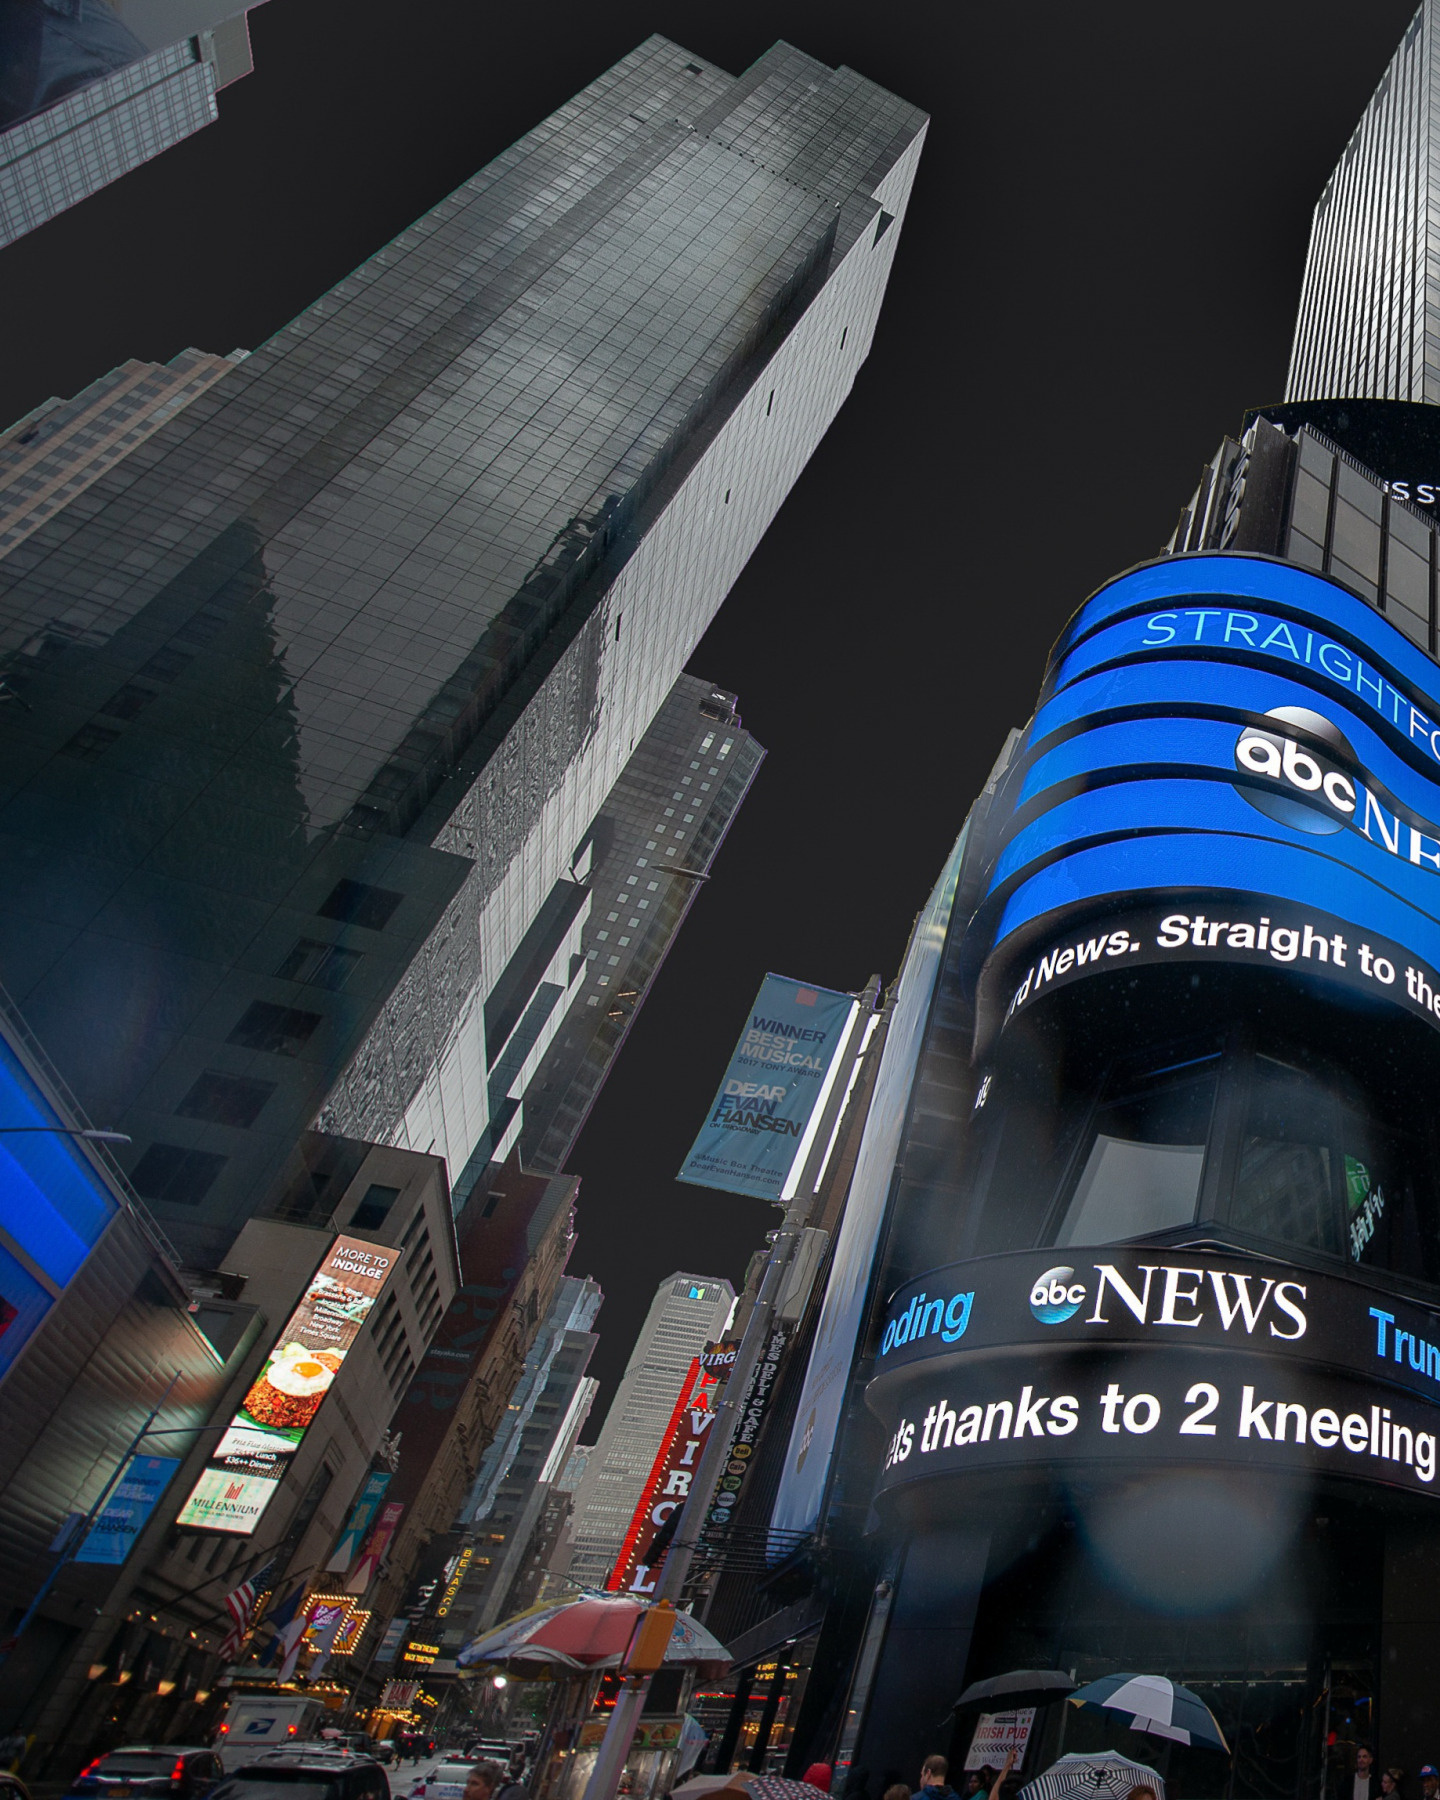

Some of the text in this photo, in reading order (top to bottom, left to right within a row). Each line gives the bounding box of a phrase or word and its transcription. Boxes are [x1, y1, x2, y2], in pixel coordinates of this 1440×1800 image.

[1236, 735, 1356, 813] abc
[1034, 928, 1140, 990] News.
[1156, 914, 1347, 967] Straight
[1358, 943, 1396, 985] to
[745, 1029, 798, 1051] BEST
[752, 1015, 828, 1044] WINNER
[737, 1056, 822, 1079] 2017 TONY AWARD
[740, 1042, 824, 1072] MUSICAL
[723, 1078, 787, 1103] DEAR
[718, 1094, 777, 1116] EVAN
[711, 1108, 803, 1138] HANSEN
[721, 1123, 761, 1135] BROADWAY
[690, 1161, 781, 1186] DearEvanHansen.com
[701, 1154, 784, 1178] Music Box Theatre
[331, 1257, 384, 1280] INDULGE
[336, 1247, 389, 1268] MORE TO
[1029, 1278, 1086, 1310] abc
[1085, 1264, 1308, 1340] NEWS
[309, 1320, 340, 1333] New York
[312, 1313, 344, 1326] Broadway
[299, 1327, 341, 1341] Times Square
[699, 1350, 739, 1367] VIRG
[920, 1386, 1079, 1453] thanks
[1099, 1392, 1161, 1436] to
[1180, 1382, 1218, 1435] 2
[1238, 1384, 1436, 1483] kneeling
[249, 1460, 274, 1470] Dinner
[255, 1451, 276, 1461] Lunch
[191, 1498, 259, 1516] MILLENNIUM
[438, 1548, 472, 1616] BELASCO
[977, 1726, 1028, 1739] IRISH PUB
